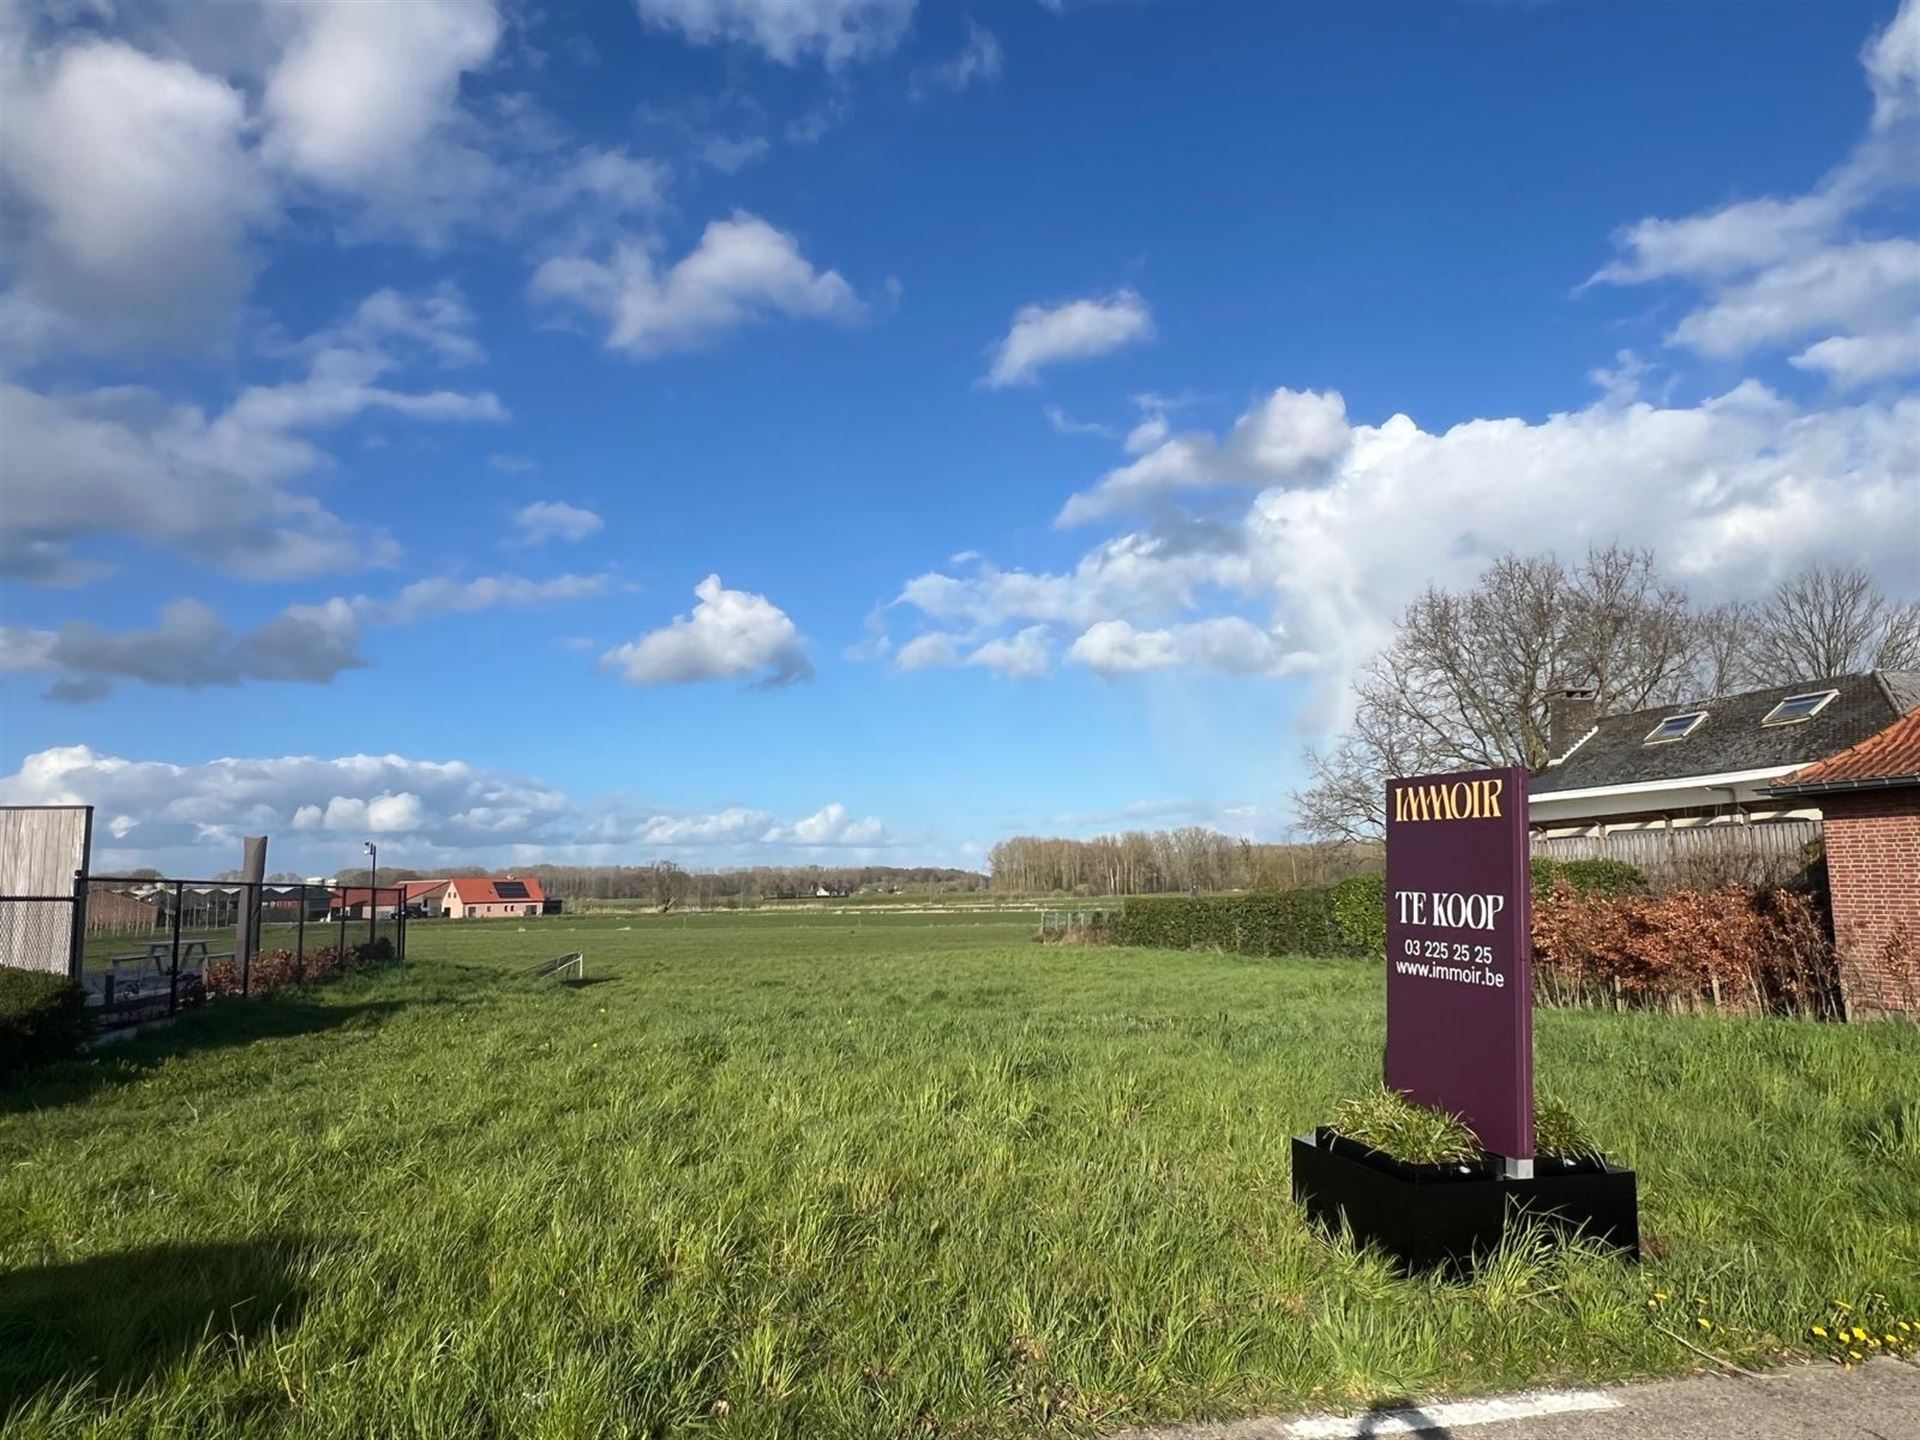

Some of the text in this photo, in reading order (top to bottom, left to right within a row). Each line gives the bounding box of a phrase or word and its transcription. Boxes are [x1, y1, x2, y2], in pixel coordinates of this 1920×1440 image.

[1395, 779, 1502, 822] IMMOIR
[1395, 891, 1504, 930] TE KOOP
[1404, 939, 1492, 964] 03 225 25 25
[1396, 960, 1504, 988] www.immoir.be
